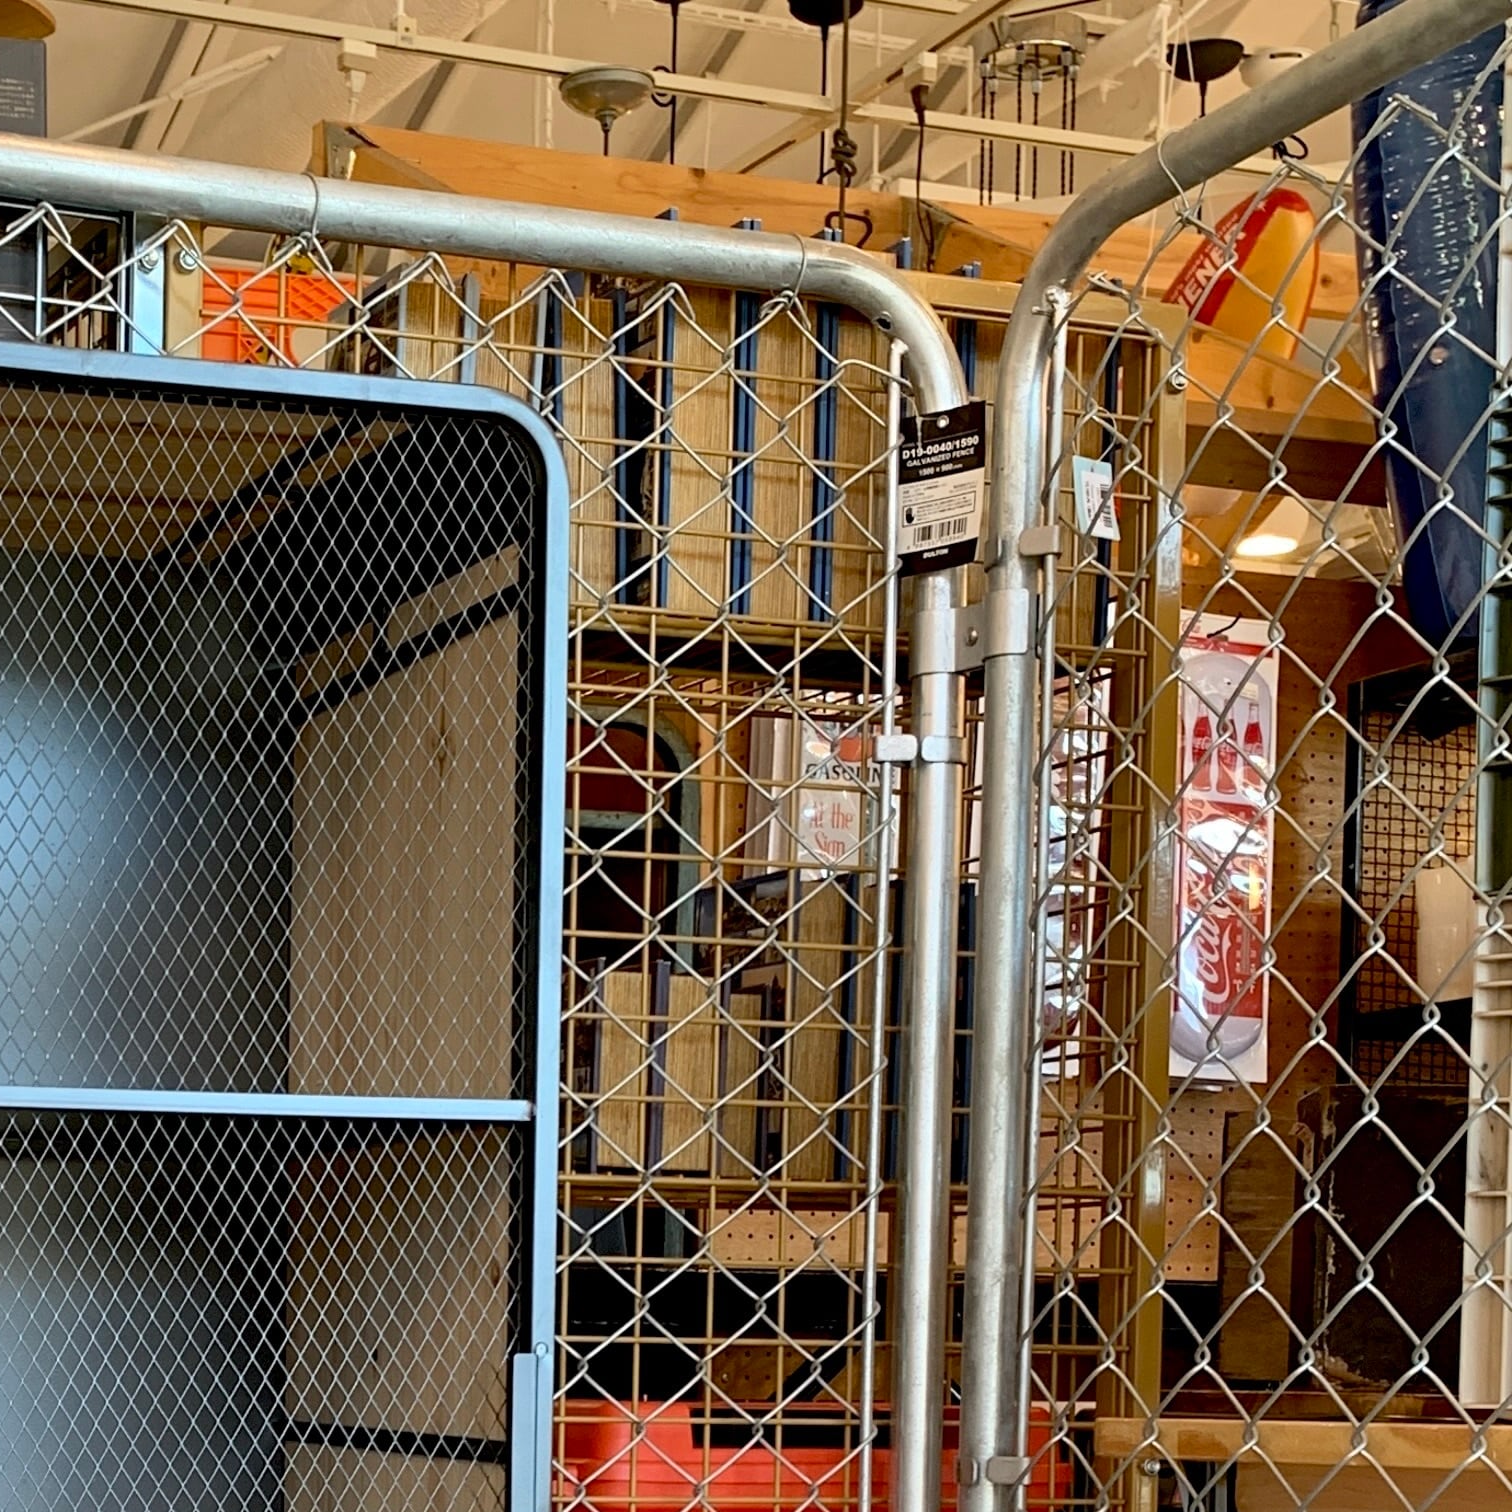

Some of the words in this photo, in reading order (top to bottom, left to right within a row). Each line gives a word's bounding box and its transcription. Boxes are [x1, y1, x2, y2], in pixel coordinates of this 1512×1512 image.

[1176, 223, 1246, 310] IENER
[906, 451, 952, 468] GALVANIZED
[952, 446, 975, 460] FENCE
[831, 800, 854, 830] the
